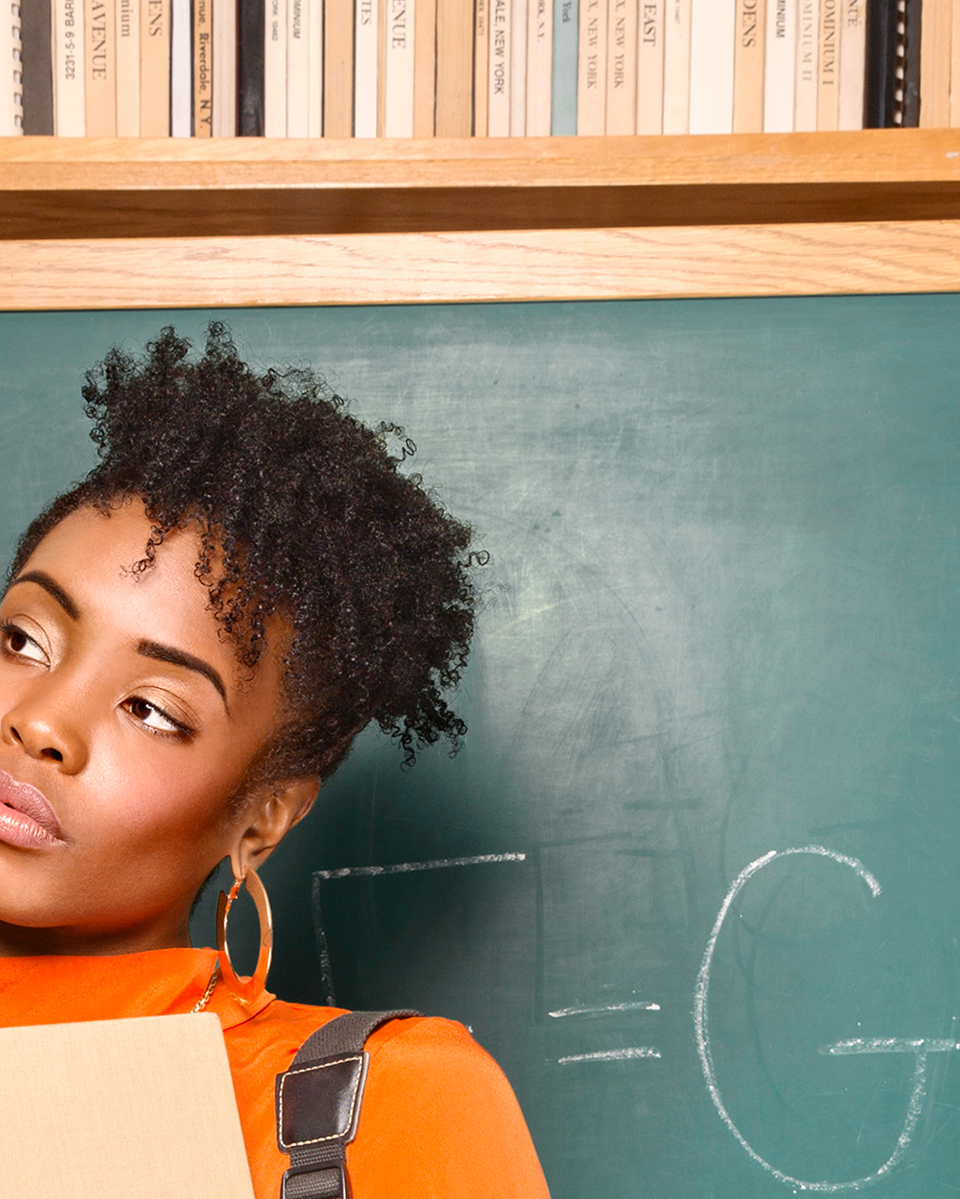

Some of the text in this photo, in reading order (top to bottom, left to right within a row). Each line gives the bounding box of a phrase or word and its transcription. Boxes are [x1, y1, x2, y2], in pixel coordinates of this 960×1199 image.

[65, 0, 75, 80] 3231-5-9 BAR
[92, 0, 107, 81] AVENUE
[587, 17, 599, 49] NEW
[614, 17, 626, 49] NEW
[643, 3, 657, 47] EAST
[801, 0, 813, 63] MINIUM
[494, 29, 505, 57] NEW
[198, 32, 210, 94] Riverdale,
[494, 61, 505, 95] YORK
[586, 54, 598, 89] YORK
[613, 54, 626, 89] YORK
